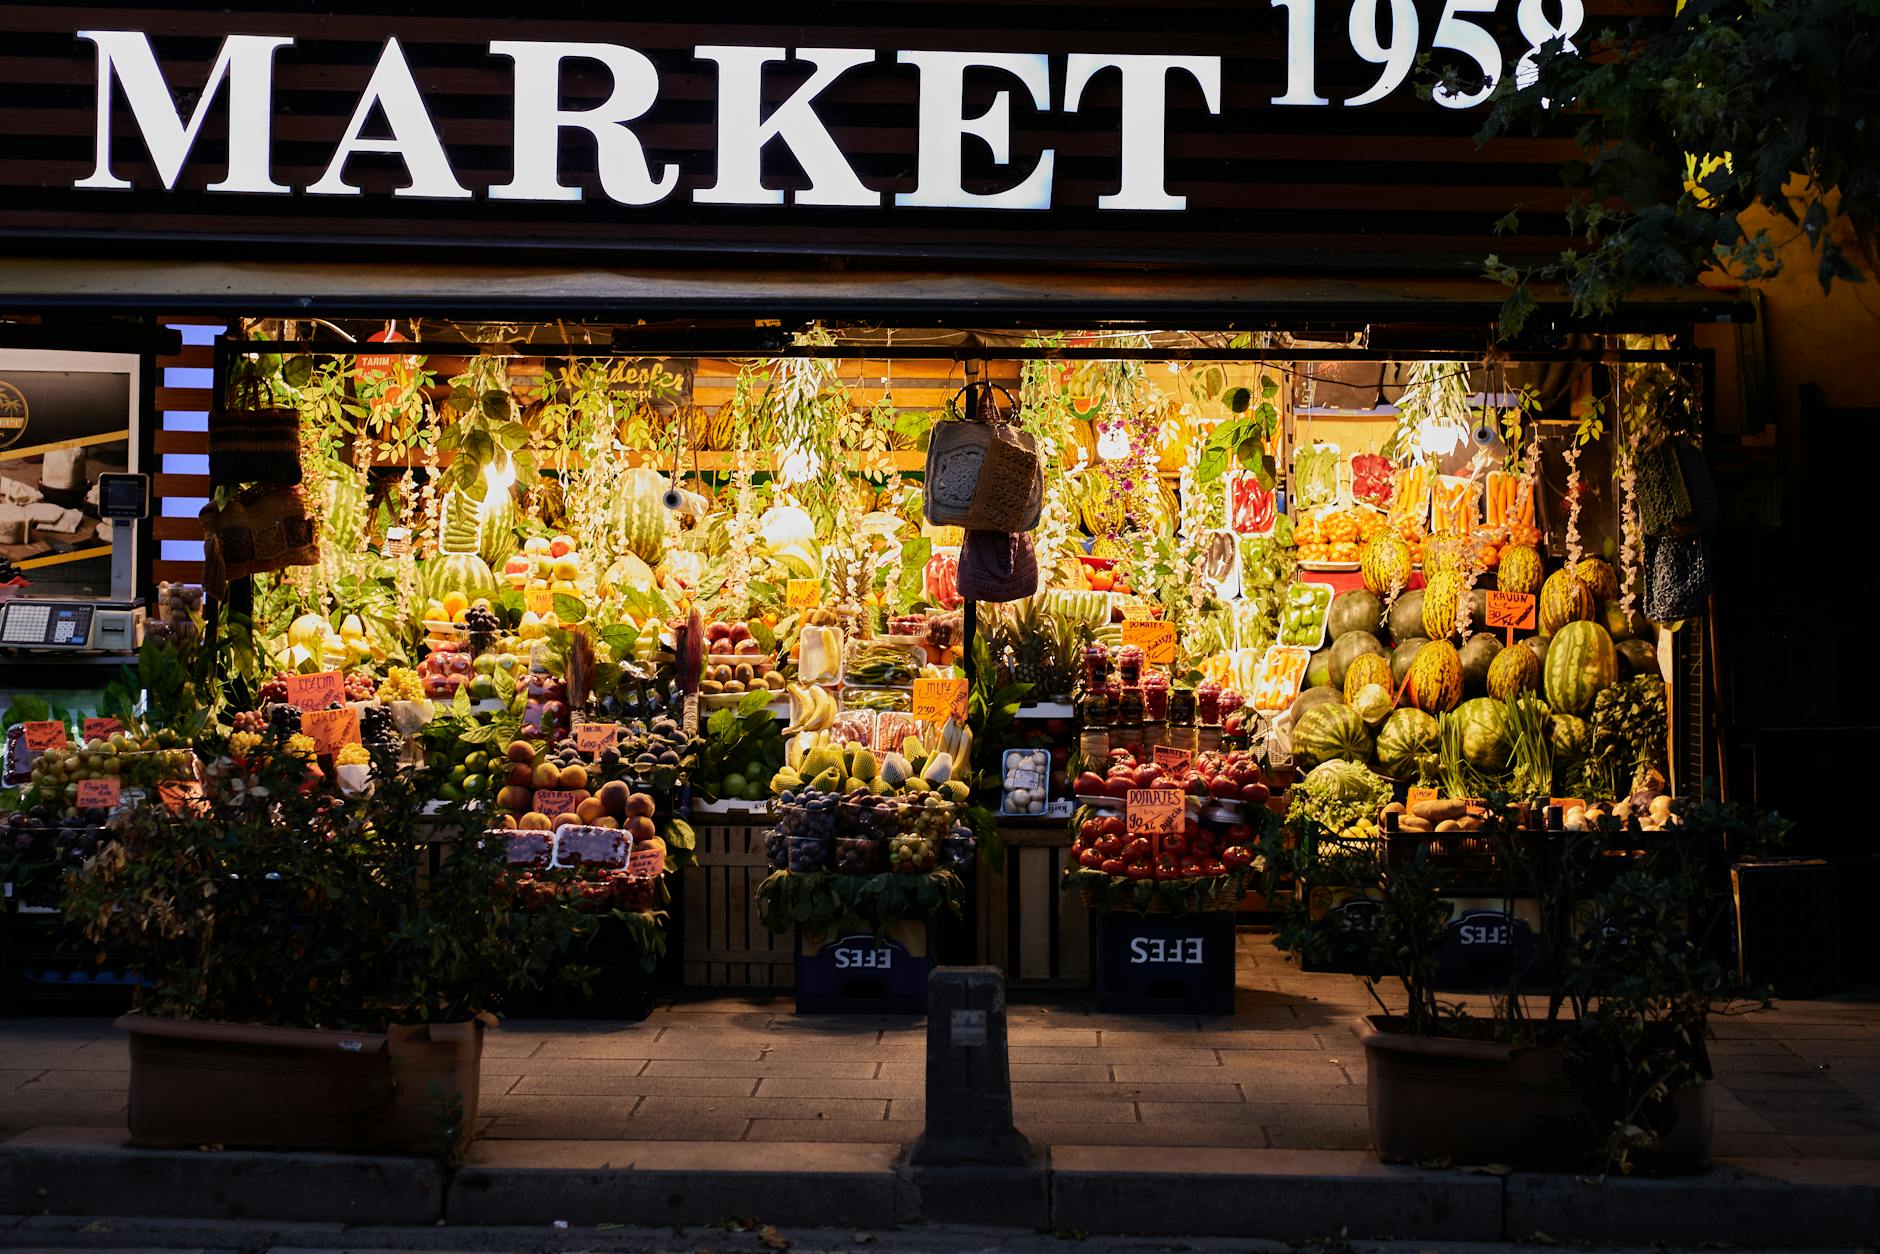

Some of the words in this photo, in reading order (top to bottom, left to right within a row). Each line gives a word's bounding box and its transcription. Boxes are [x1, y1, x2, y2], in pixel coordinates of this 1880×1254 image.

[1270, 0, 1585, 109] 1958
[74, 30, 1222, 210] MARKET
[362, 357, 390, 366] TARIM
[1493, 592, 1528, 603] KAVUN
[1129, 790, 1181, 806] DOMATES
[834, 947, 892, 969] EFES
[1130, 937, 1204, 964] EFES
